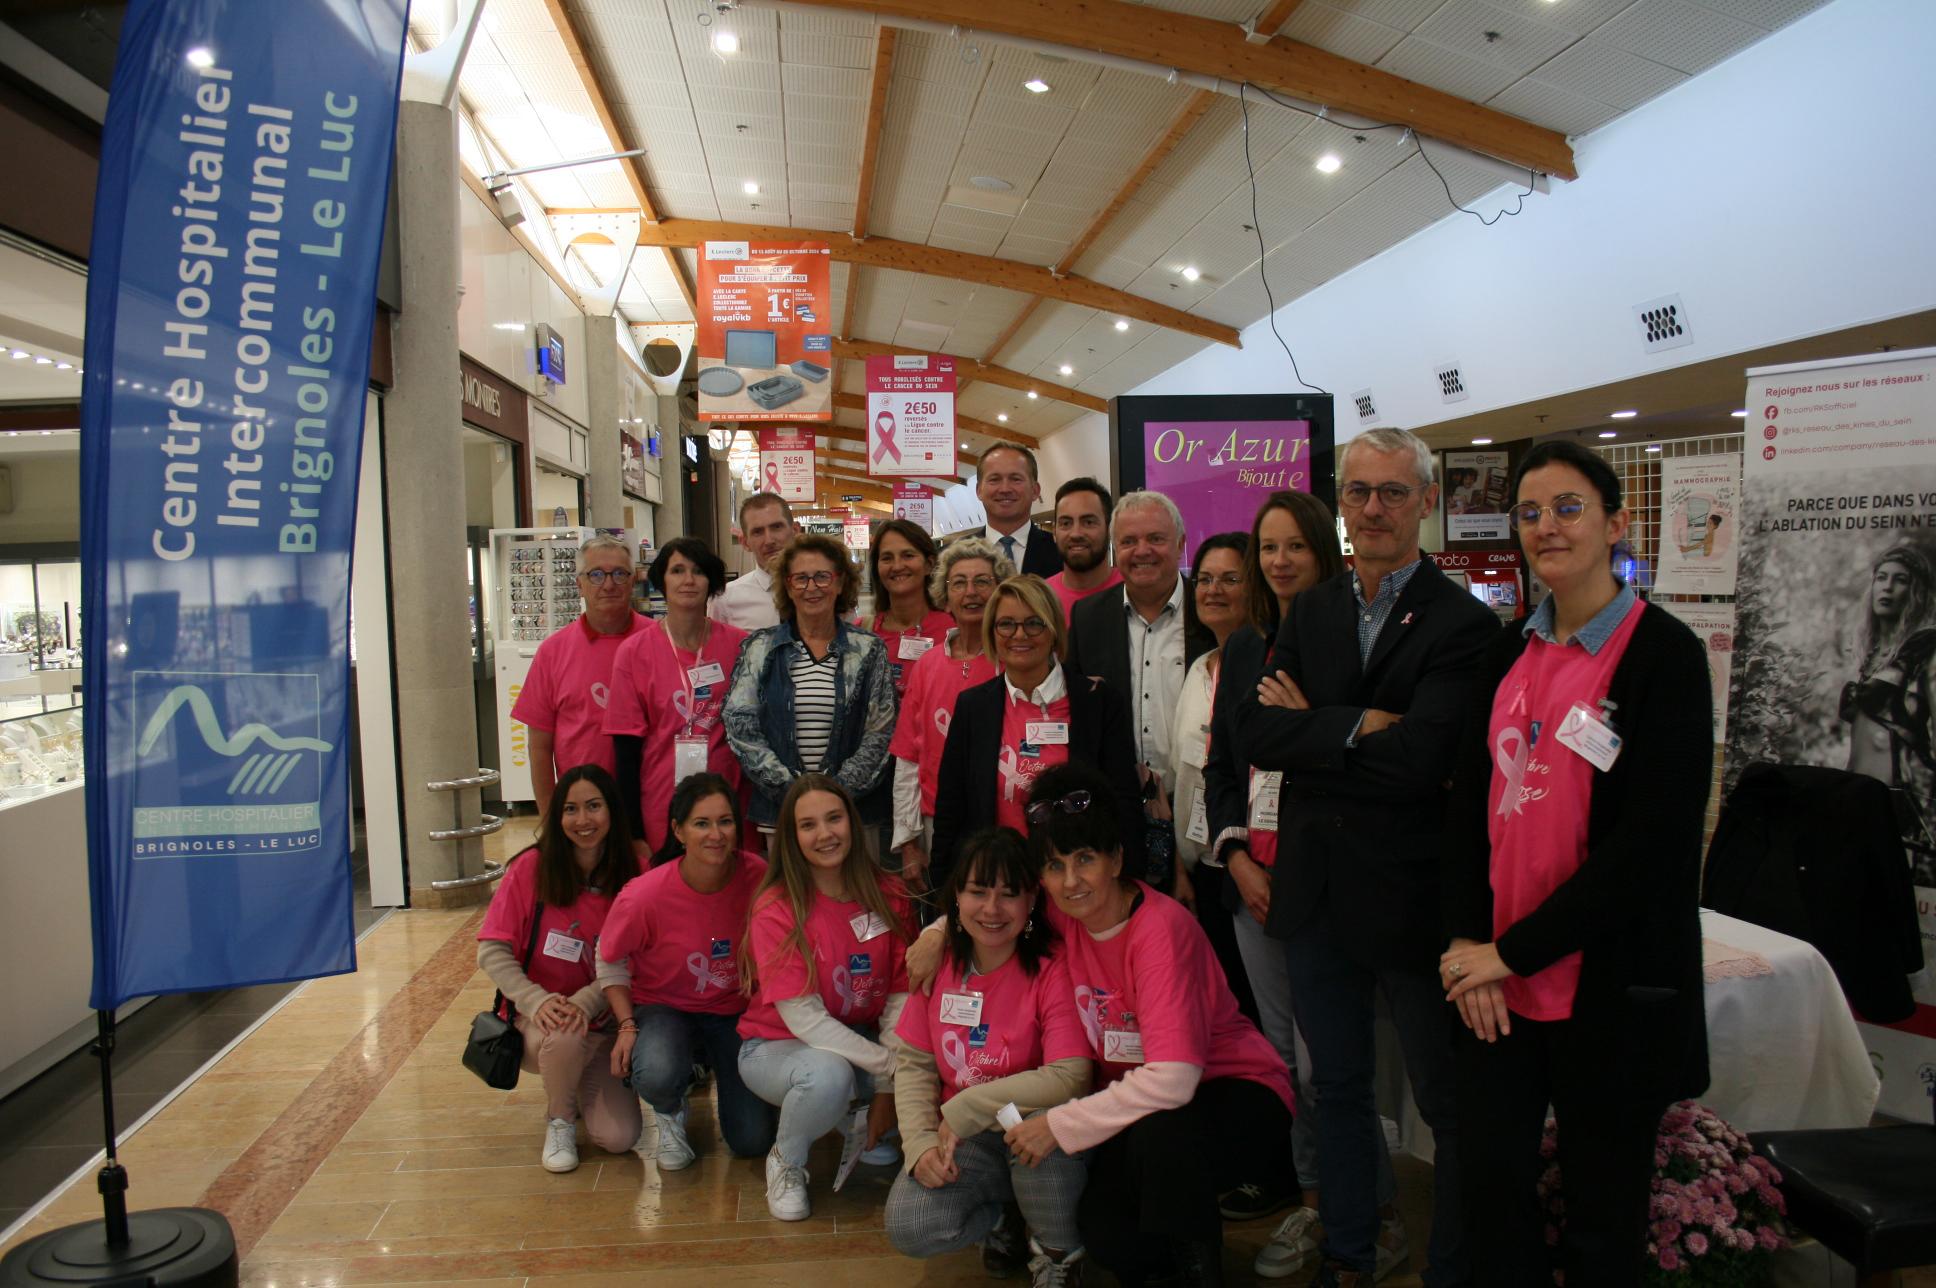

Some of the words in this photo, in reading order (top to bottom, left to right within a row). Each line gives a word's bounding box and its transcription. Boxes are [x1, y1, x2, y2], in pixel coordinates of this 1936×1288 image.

[321, 91, 359, 183] Luc
[163, 67, 234, 360] Hospitalier
[300, 197, 348, 259] Le
[217, 103, 294, 529] Intercommunal
[465, 372, 501, 418] MONTRES
[1765, 384, 1813, 398] Rejoignez
[1815, 381, 1840, 392] nous
[1842, 379, 1860, 390] sur
[1862, 378, 1878, 387] les
[1880, 373, 1924, 386] réseaux
[904, 402, 937, 415] 2€50
[280, 306, 336, 555] Brignoles
[1153, 429, 1204, 463] Or
[1212, 428, 1310, 463] Azur
[153, 377, 205, 562] Centre
[1787, 497, 1834, 512] PARCE
[1838, 496, 1868, 510] QUE
[1872, 493, 1914, 509] DANS
[1845, 516, 1866, 530] DU
[1871, 514, 1905, 529] SEIN
[1488, 553, 1516, 562] cewe
[508, 684, 526, 768] CALYO
[135, 808, 204, 825] CENTRE
[208, 805, 314, 823] HOSPITALIER
[136, 840, 236, 854] BRIGNOLES
[260, 838, 279, 849] LE
[288, 834, 318, 847] LUC
